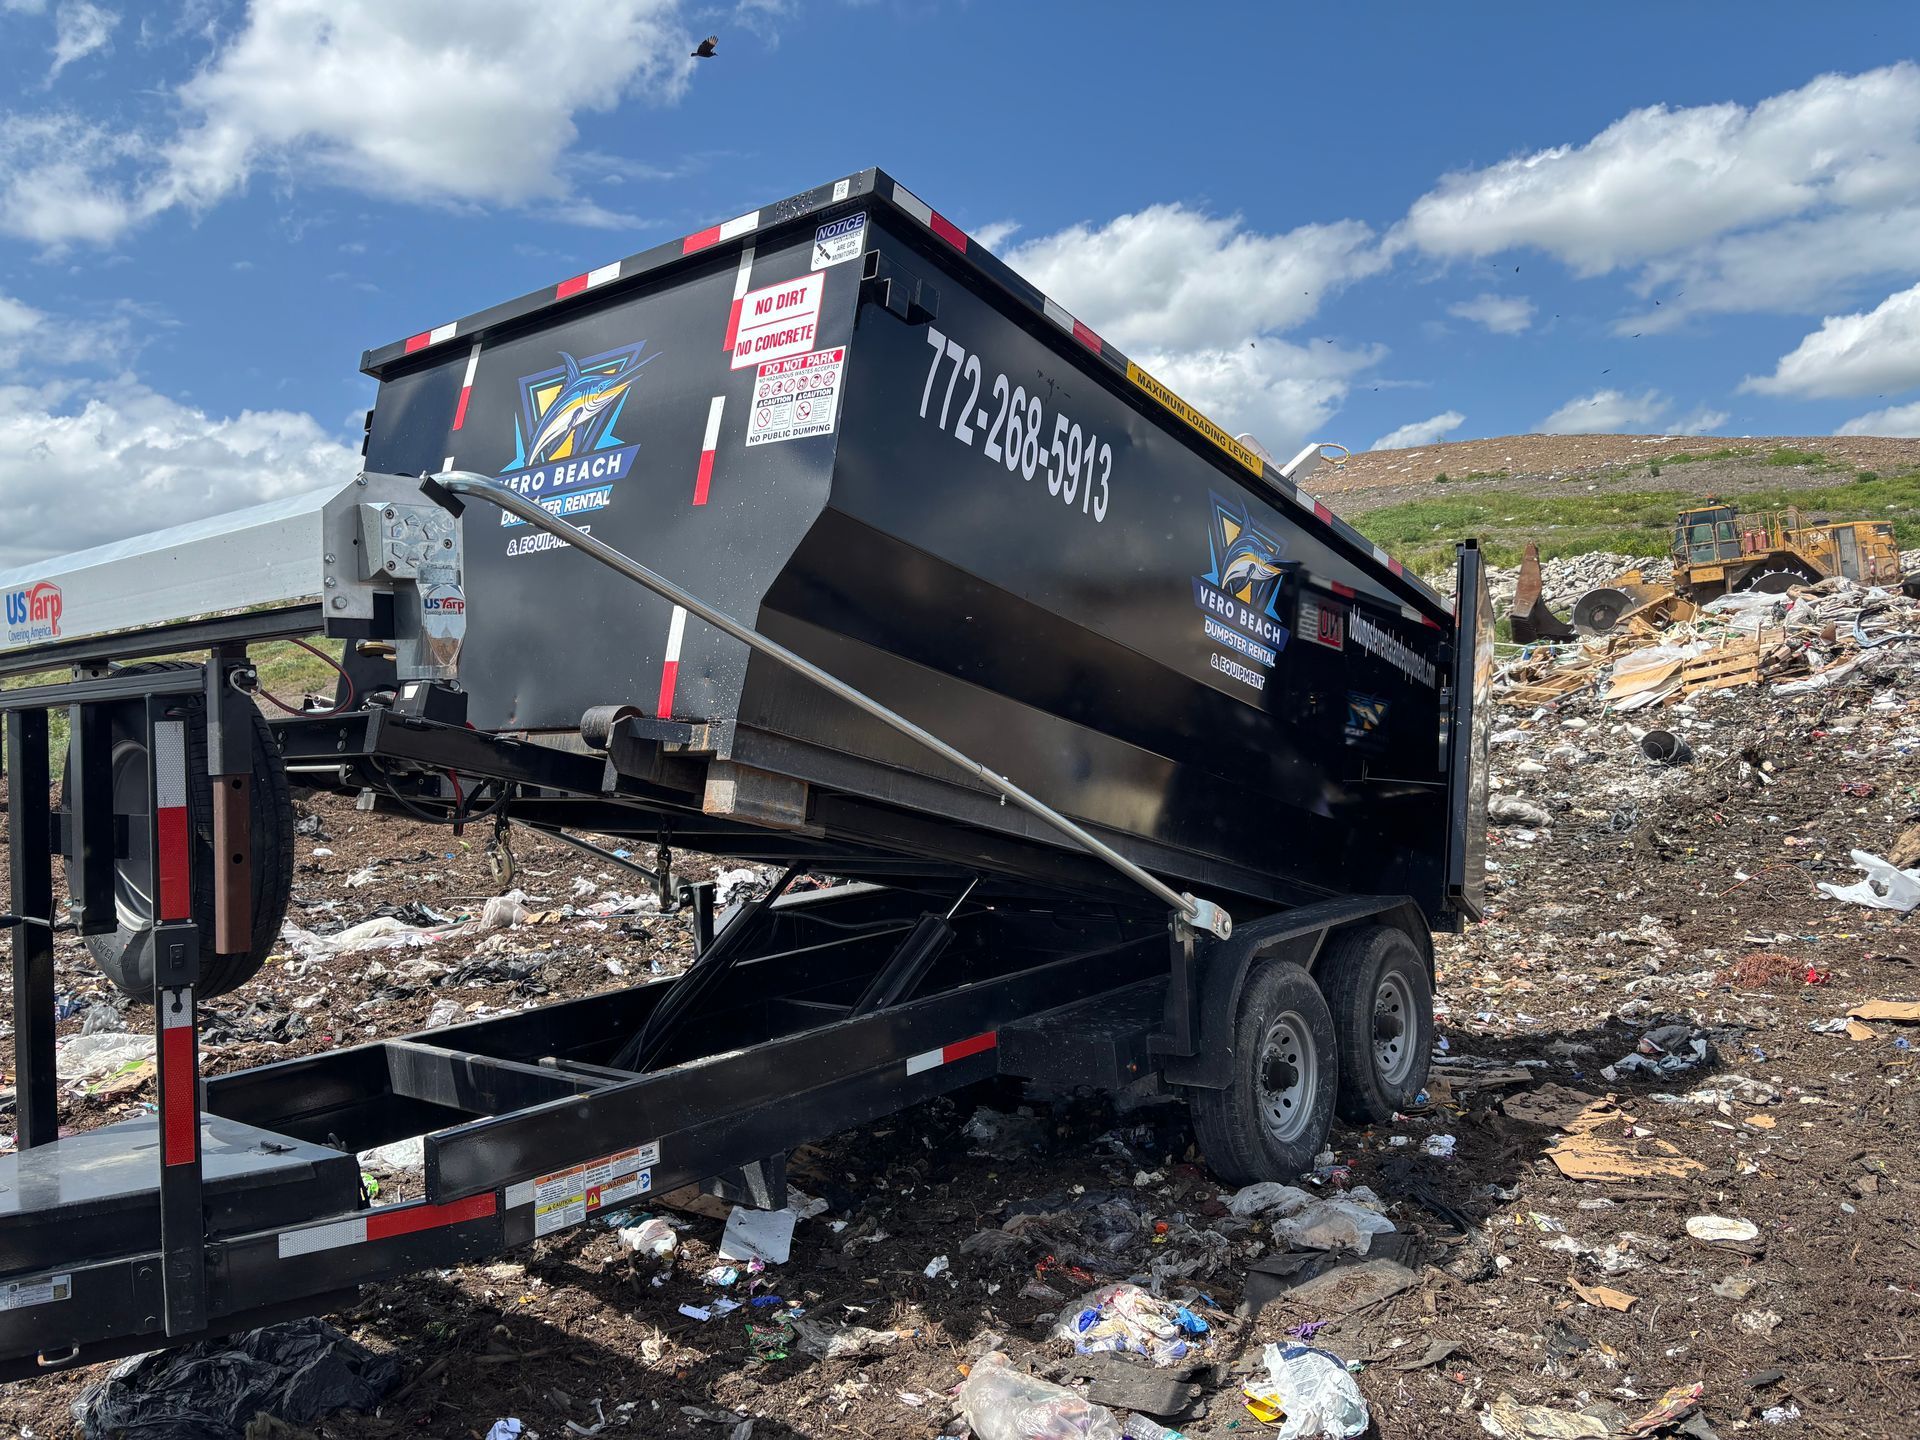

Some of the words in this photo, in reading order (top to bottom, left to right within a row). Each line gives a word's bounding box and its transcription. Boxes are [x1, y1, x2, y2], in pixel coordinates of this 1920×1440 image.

[818, 215, 864, 240] NOTICE
[837, 243, 846, 251] ARE
[847, 240, 856, 248] GPS
[755, 297, 773, 316] NO
[776, 287, 808, 310] DIRT
[736, 340, 752, 357] NO
[755, 324, 814, 352] CONCRETE
[764, 364, 780, 375] DO
[782, 358, 804, 371] NOT
[806, 351, 836, 367] PARK
[814, 364, 840, 372] ACCEPTED
[763, 396, 792, 406] CAUTION
[802, 389, 832, 399] CAUTION
[762, 430, 791, 441] PUBLIC
[792, 424, 831, 436] DUMPING
[919, 326, 1112, 523] 772-268-5913
[1137, 373, 1185, 416] MAXIMUM
[1187, 410, 1227, 447] LOADING
[1228, 440, 1255, 468] LEVEL
[553, 453, 622, 486] BEACH
[563, 490, 611, 513] RENTAL
[506, 539, 518, 556] &
[1200, 585, 1234, 619] VERO
[1240, 608, 1281, 645] BEACH
[1204, 619, 1247, 653] DUMPSTER
[1248, 642, 1277, 668] RENTAL
[1211, 652, 1220, 670] &
[1219, 656, 1266, 690] EQUIPMENT
[607, 1173, 636, 1188] WARNING
[552, 1199, 573, 1208] CAUTION
